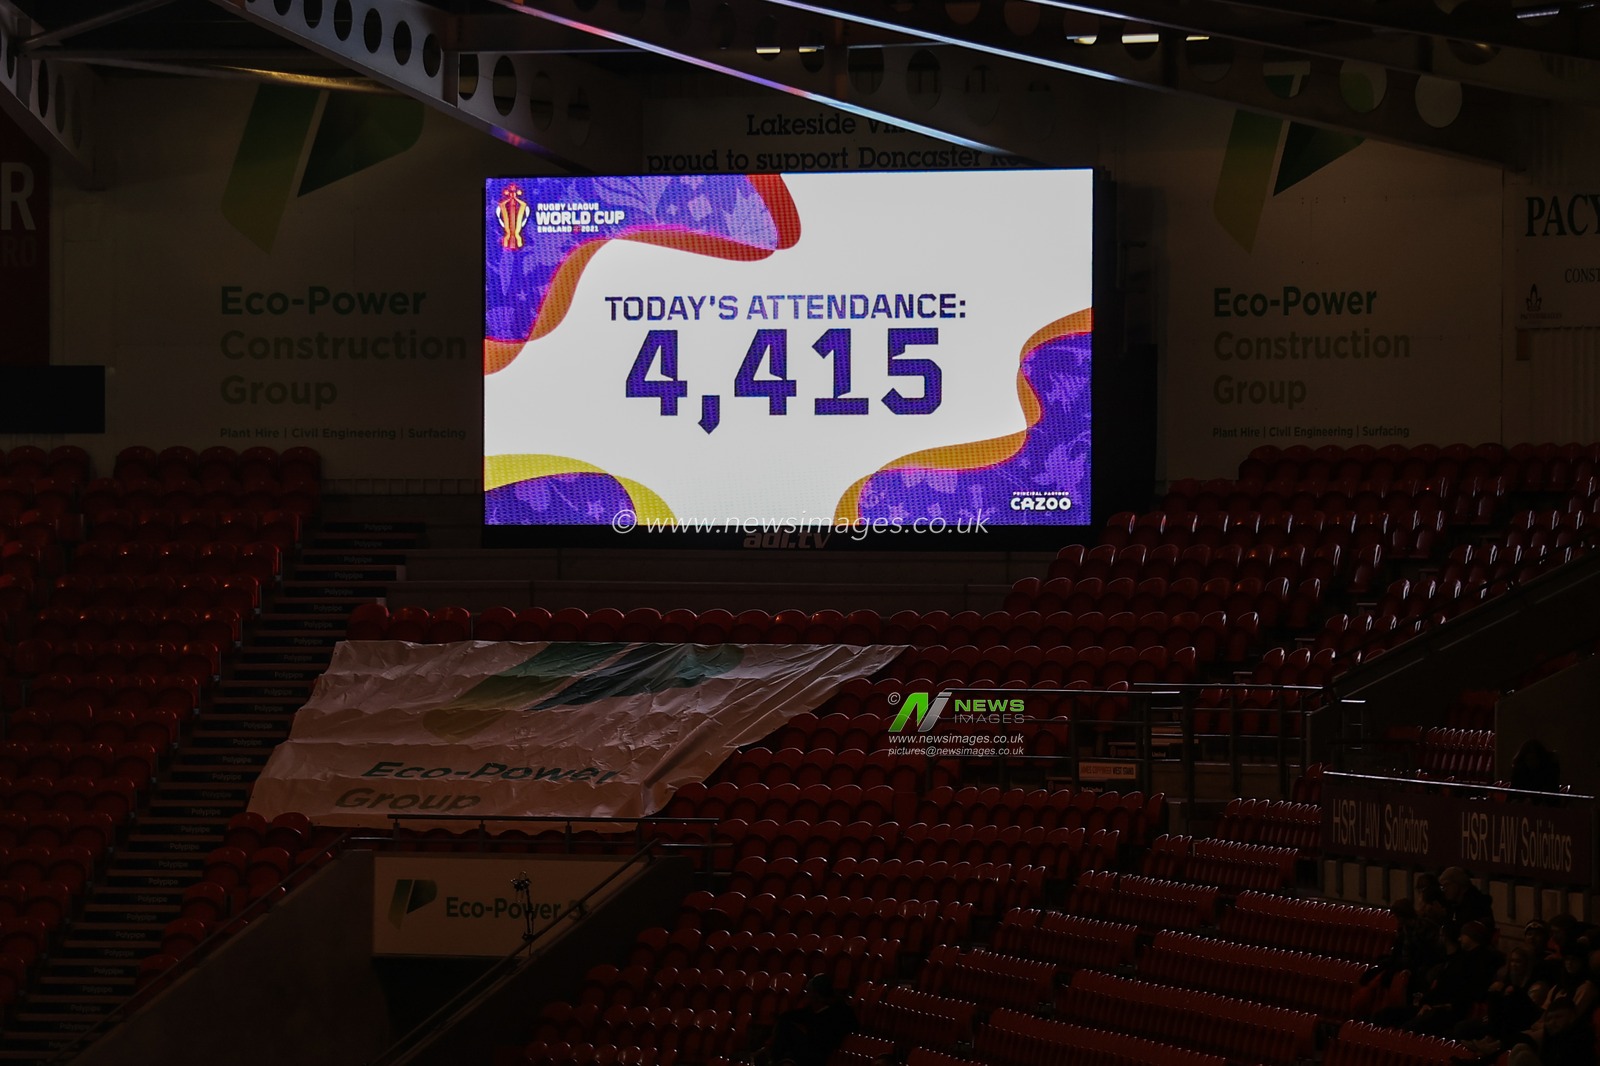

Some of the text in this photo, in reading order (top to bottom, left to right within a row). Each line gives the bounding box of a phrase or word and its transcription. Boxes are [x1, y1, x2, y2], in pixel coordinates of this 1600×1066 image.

[746, 114, 856, 136] Lakeside
[647, 152, 718, 172] proud
[726, 151, 748, 170] to
[756, 148, 849, 172] support
[858, 144, 981, 168] Doncaster
[535, 211, 625, 226] WORLD CUP
[537, 202, 599, 211] RUGBY LEAGUE
[537, 225, 599, 233] ENGLAND 2021
[220, 285, 427, 316] Eco-Power
[605, 293, 967, 322] TODAY'S ATTENDANCE:
[1213, 286, 1378, 317] Eco-Power
[219, 329, 468, 361] Construction
[1213, 327, 1412, 361] Construction
[219, 374, 339, 411] Group
[625, 327, 943, 434] 4,415
[1213, 374, 1308, 411] Group
[219, 427, 467, 441] Plant Hire Civil Engineering Surfacing
[1212, 424, 1411, 439] Plant Hire Civil Engineering Surfacing
[1010, 497, 1072, 511] CAZOO
[361, 761, 619, 784] Eco-Power
[335, 788, 480, 810] Group
[1332, 799, 1430, 856] HSR LAW Solicitors
[1461, 811, 1573, 873] HSR LAW Solicitors
